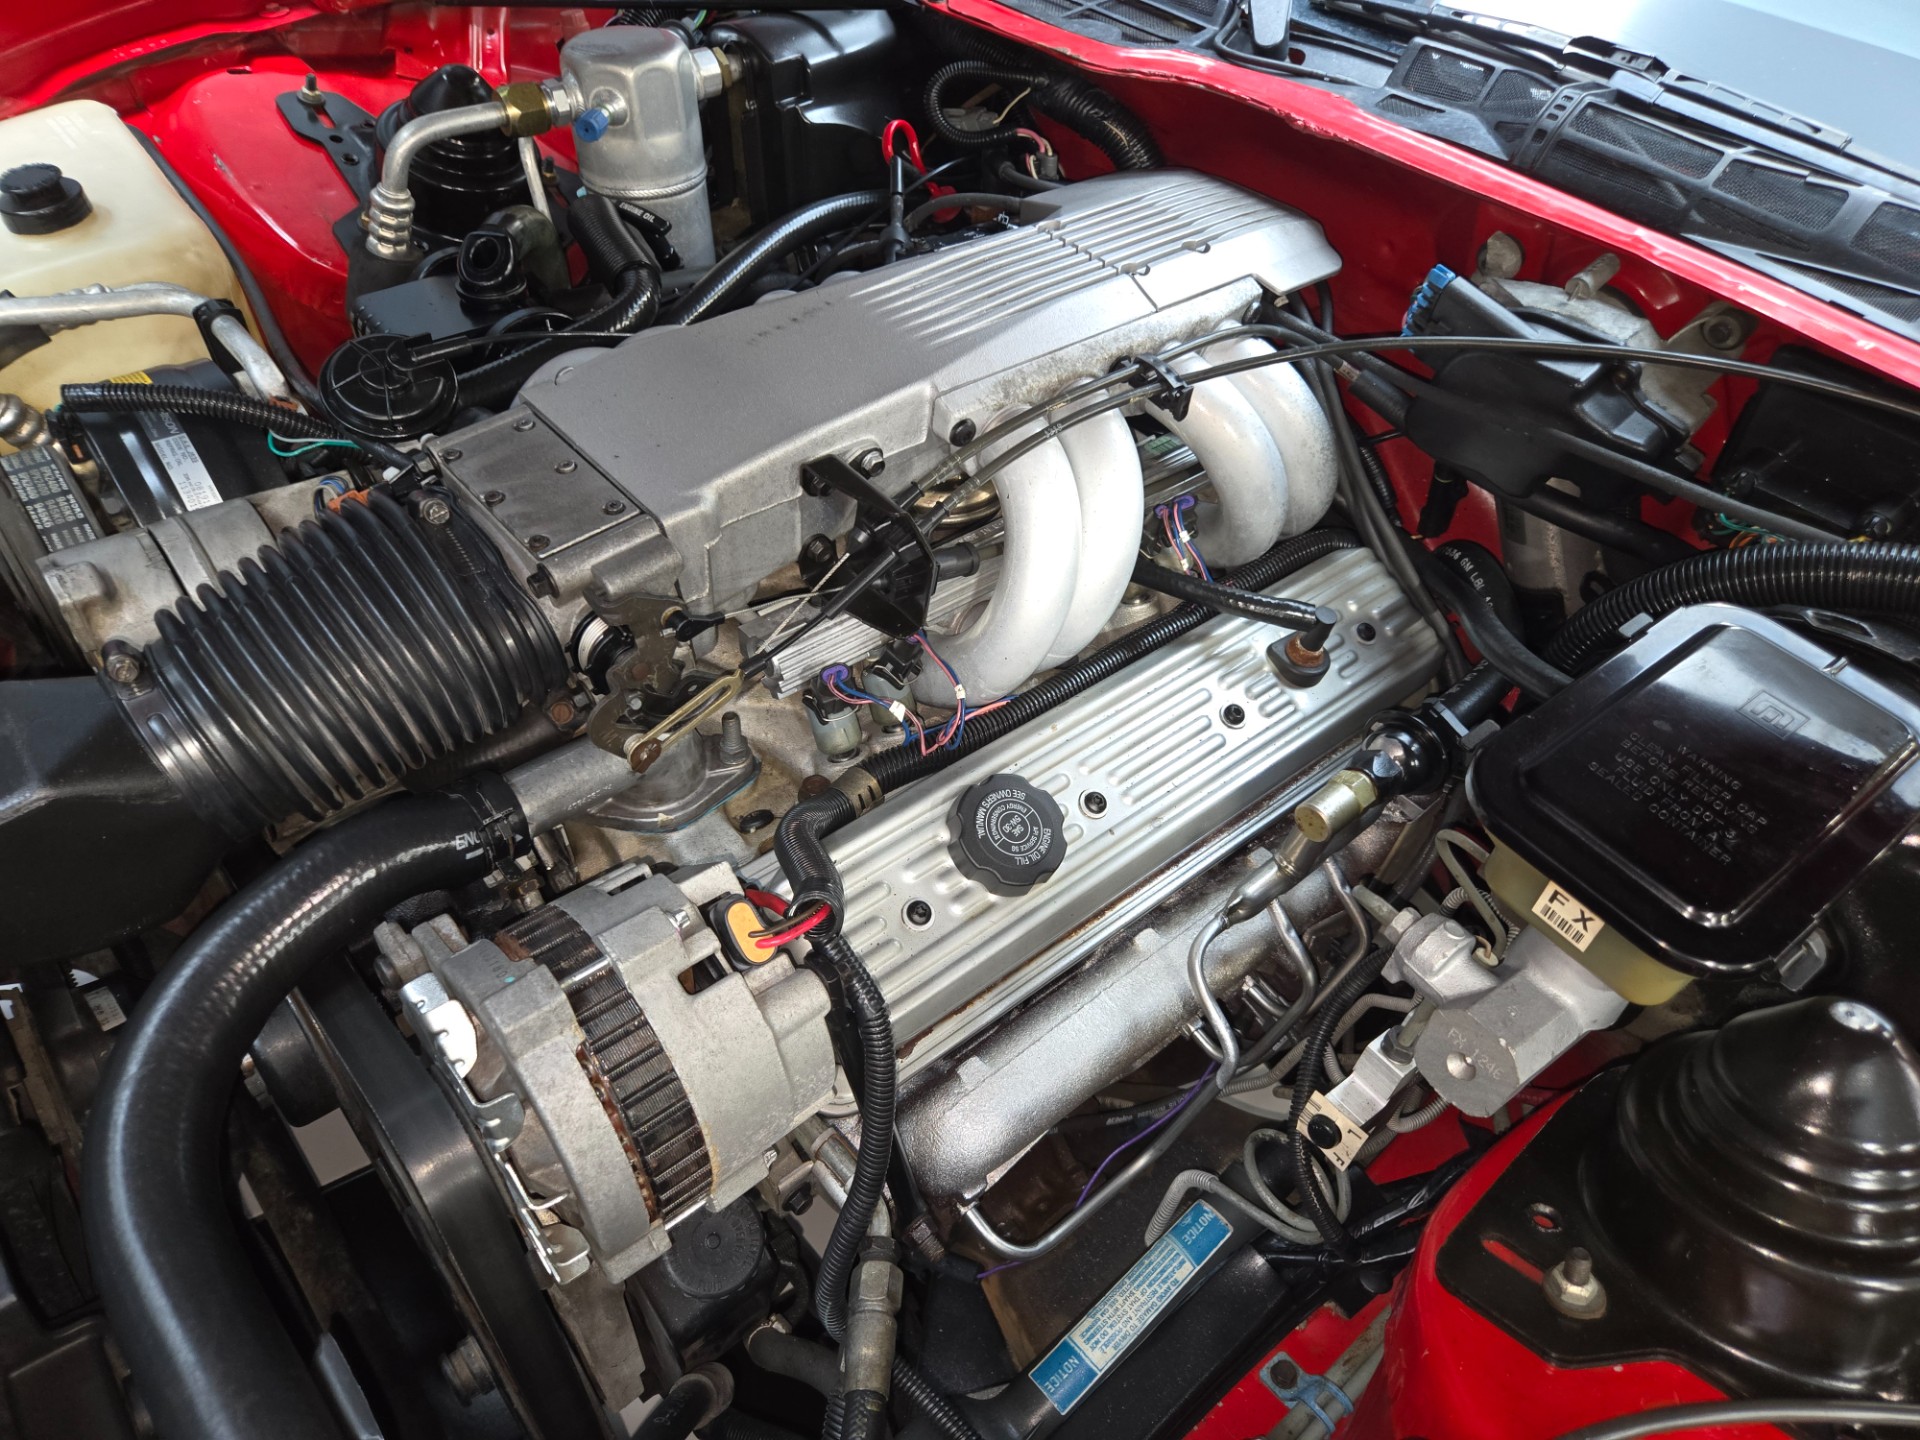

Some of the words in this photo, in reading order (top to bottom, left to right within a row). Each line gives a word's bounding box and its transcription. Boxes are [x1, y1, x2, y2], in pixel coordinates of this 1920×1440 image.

[643, 213, 655, 223] OIL
[1460, 557, 1474, 572] GM
[1676, 742, 1744, 793] WARNING
[1619, 736, 1679, 781] BEFORE
[1682, 779, 1756, 833] REMOVING
[1628, 729, 1676, 766] CLEAN
[1682, 765, 1730, 801] FILLER
[1737, 803, 1767, 826] CAP
[1012, 790, 1026, 800] SEE
[1613, 750, 1644, 775] USE
[1650, 775, 1686, 803] ONLY
[1692, 805, 1722, 828] DOT
[1006, 803, 1027, 813] ENERGY
[1588, 761, 1641, 801] SEALED
[1649, 803, 1730, 862] CONTAINER
[1615, 767, 1653, 795] FLUID
[1661, 798, 1699, 827] FROM
[1705, 828, 1719, 842] A
[976, 807, 986, 839] MANUAL
[1002, 815, 1021, 833] 5W-30
[1011, 825, 1024, 837] SAE
[1038, 828, 1052, 854] ENGINE
[1014, 856, 1029, 865] FILL
[1029, 851, 1041, 861] OIL
[1182, 1206, 1215, 1245] NOTICE
[1118, 1290, 1134, 1307] SHAFT
[1138, 1288, 1147, 1297] OF
[1106, 1306, 1119, 1319] WITH
[1136, 1301, 1157, 1323] DAMAGE
[1121, 1315, 1133, 1327] AND
[1129, 1322, 1137, 1331] TO
[1044, 1355, 1080, 1393] NOTICE
